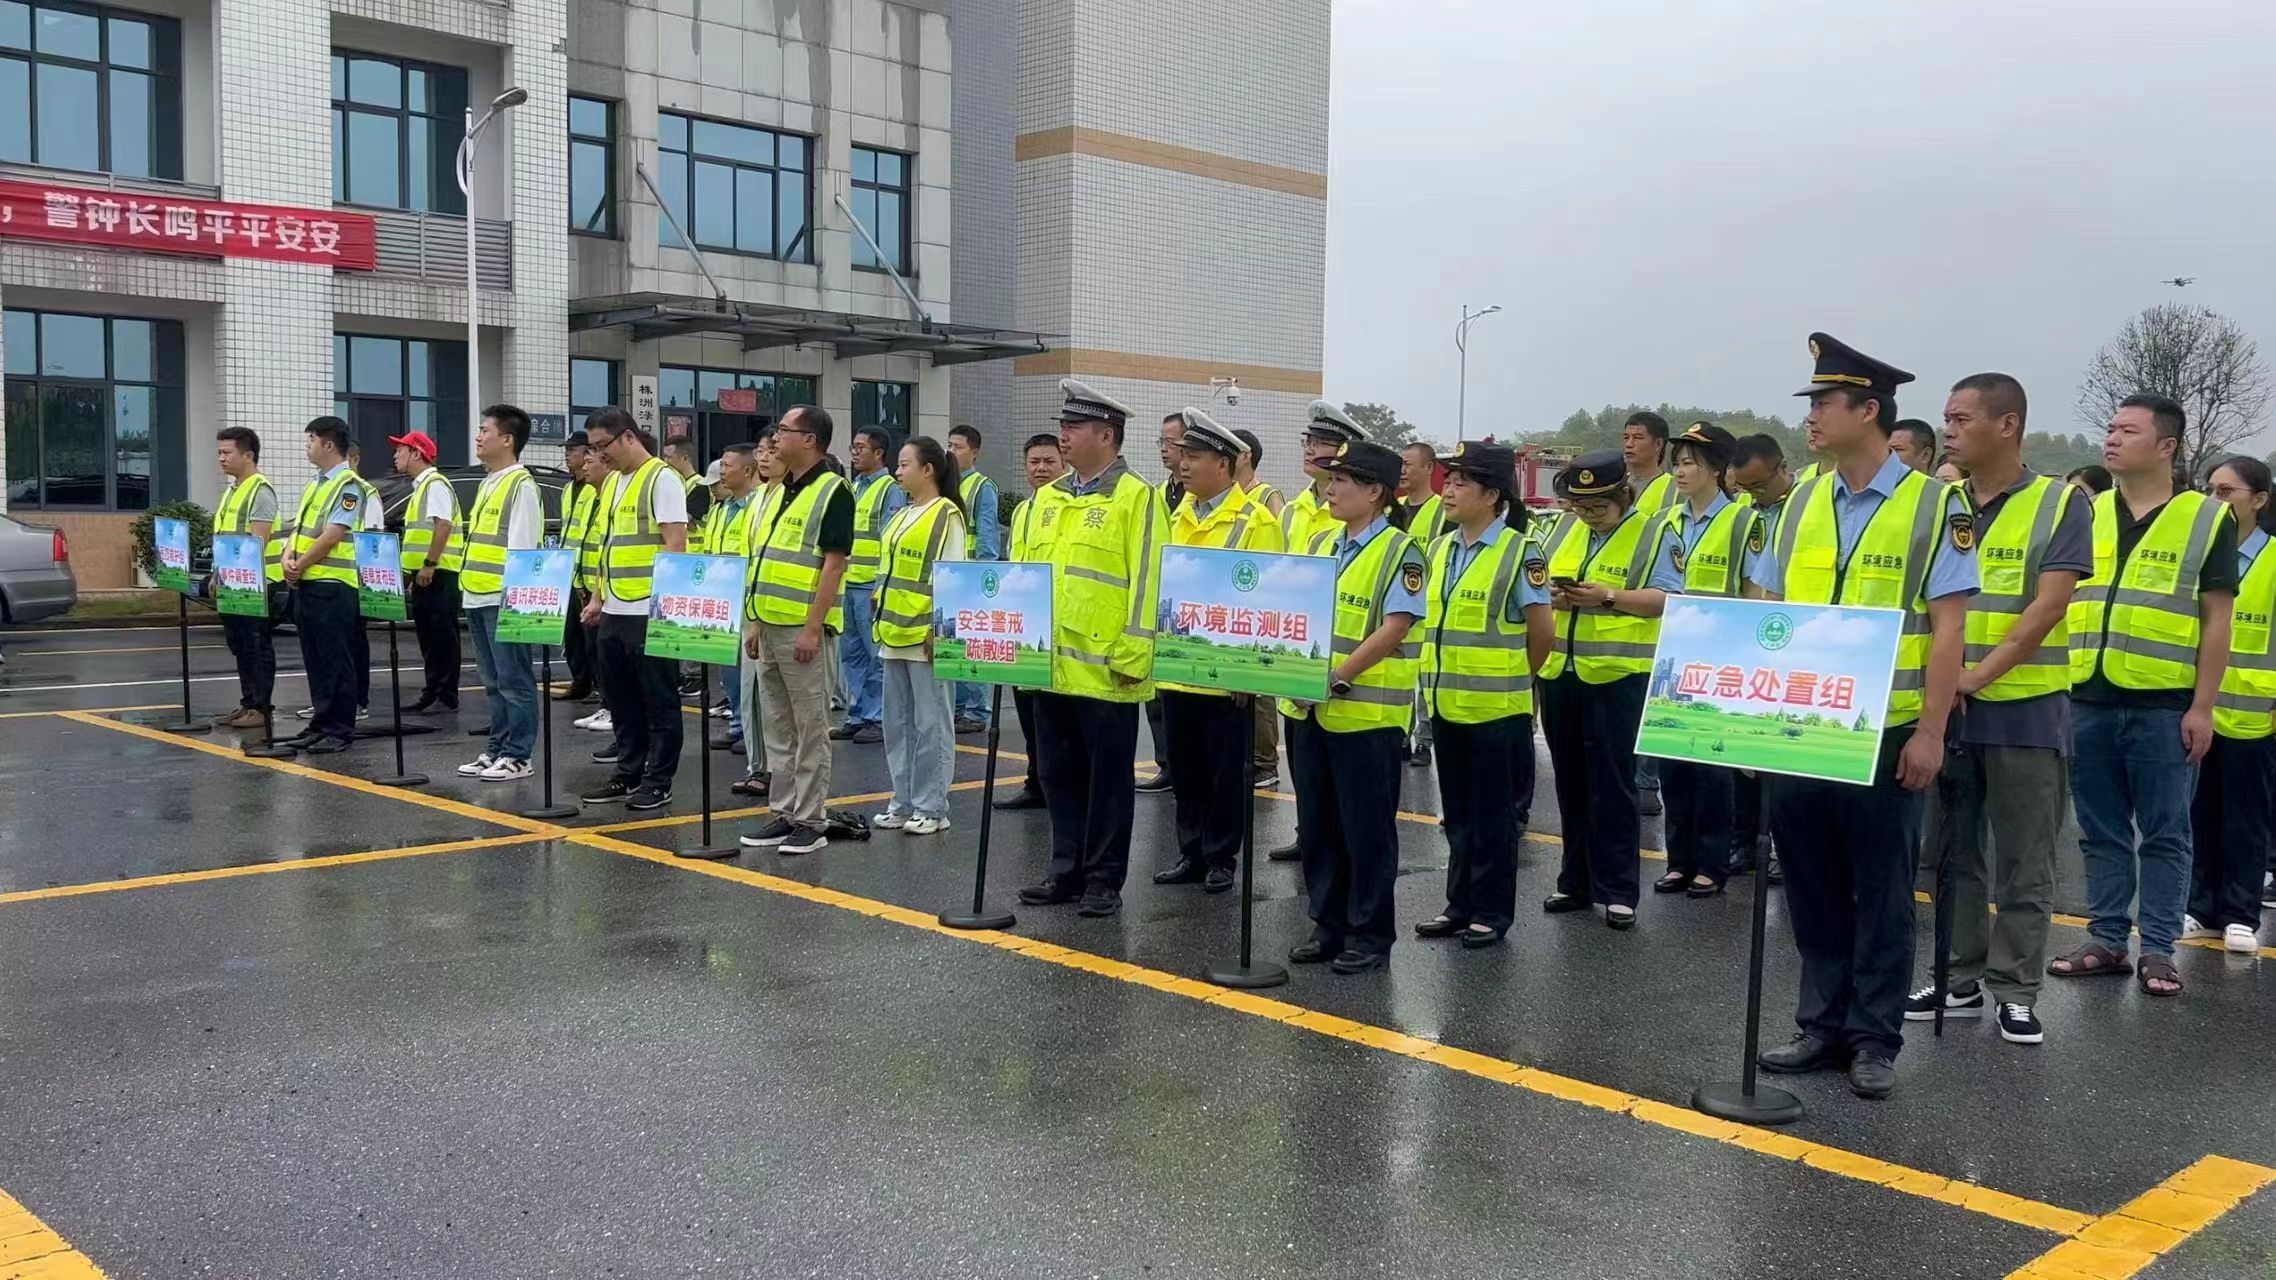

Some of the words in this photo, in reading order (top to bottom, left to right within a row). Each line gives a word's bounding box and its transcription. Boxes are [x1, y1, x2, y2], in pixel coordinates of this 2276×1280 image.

[509, 586, 559, 606] 通讯联络组
[661, 596, 729, 621] 物资保障组
[958, 609, 1024, 634] 安全警戒
[1176, 602, 1308, 642] 环境监测组
[966, 638, 1015, 662] 疏散组
[1678, 663, 1855, 710] 应急处置组
